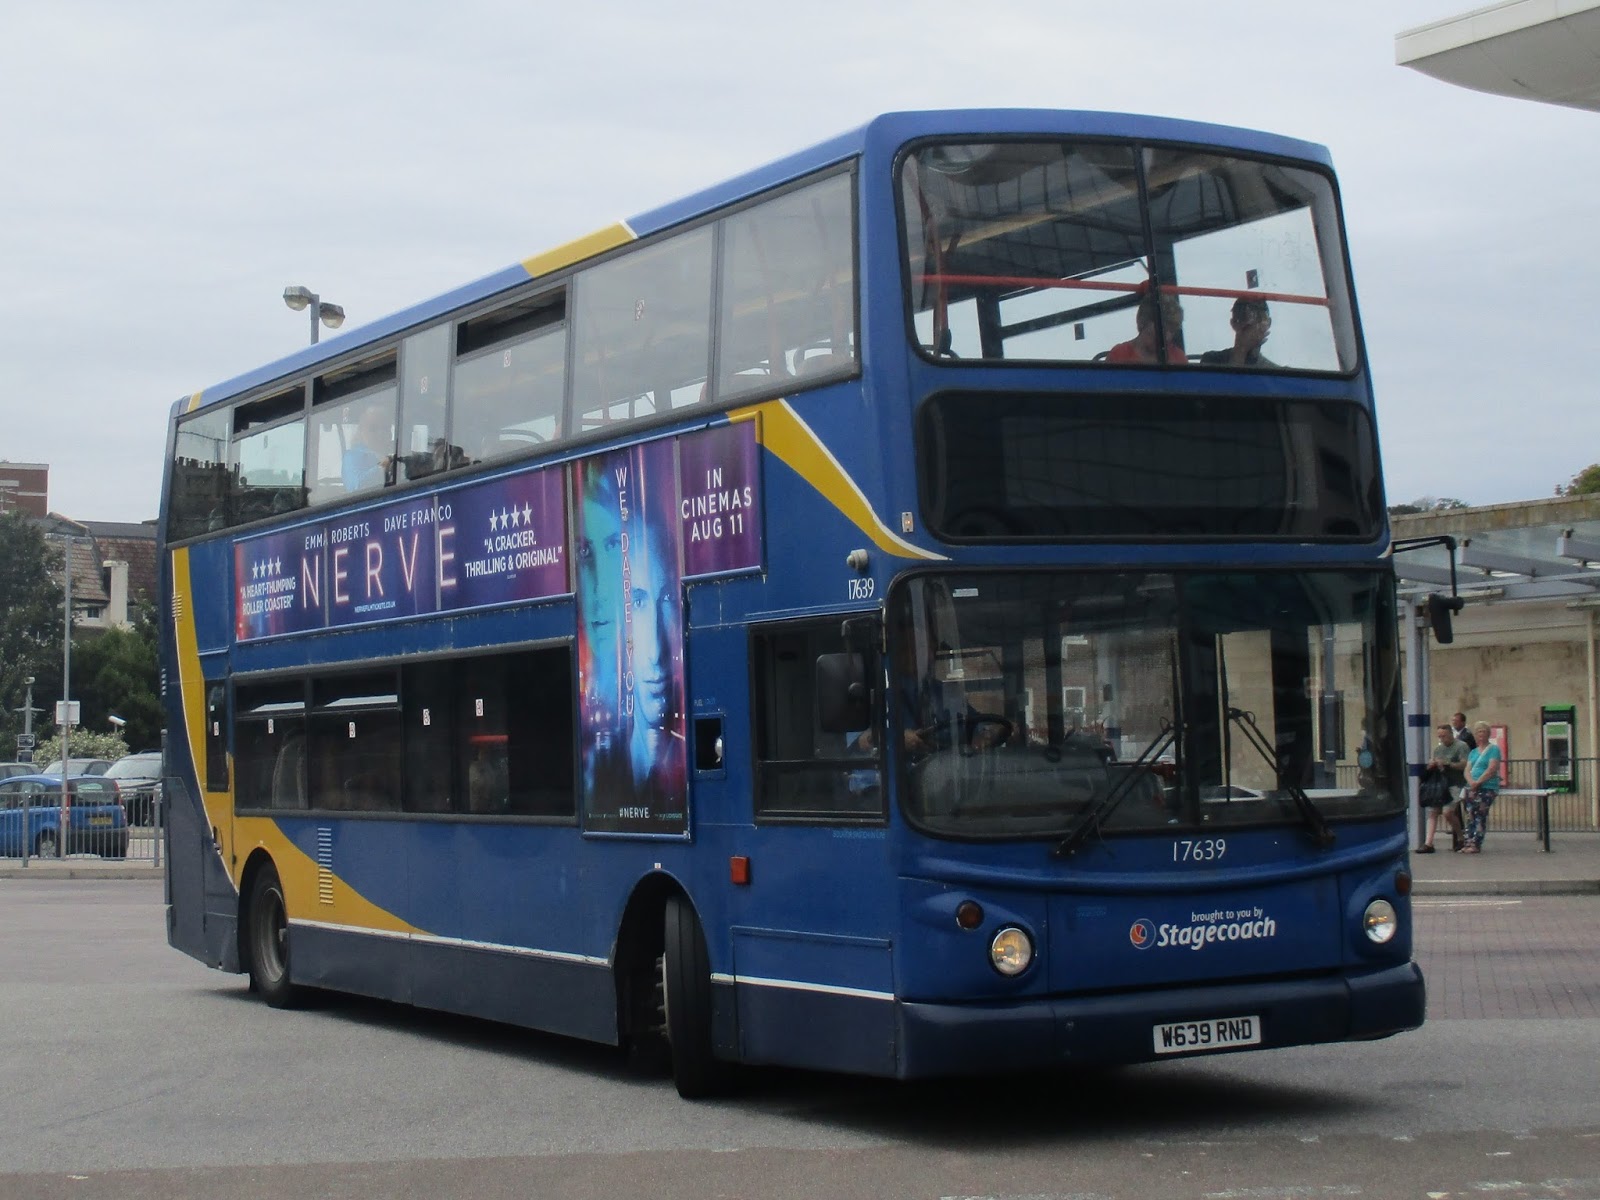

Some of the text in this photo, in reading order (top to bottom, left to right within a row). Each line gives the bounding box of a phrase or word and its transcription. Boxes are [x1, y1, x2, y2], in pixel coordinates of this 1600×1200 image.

[707, 468, 722, 489] IN
[681, 487, 752, 519] CINEMAS
[305, 504, 452, 550] EMMA ROBERTS DAVE FRANCO
[691, 514, 743, 542] AUG 11
[495, 530, 537, 552] CRACKER.
[303, 526, 457, 609] NERVE
[465, 556, 507, 578] THRILLING
[508, 556, 514, 571] &
[247, 577, 296, 598] HEART-THUMPING
[848, 577, 874, 600] 17639
[242, 600, 264, 616] ROLLER
[619, 807, 649, 819] #NERVE
[1173, 839, 1226, 862] 17639
[1191, 906, 1263, 924] brought to you by
[1157, 916, 1276, 951] Stagecoach
[1162, 1019, 1252, 1048] W639 RND
